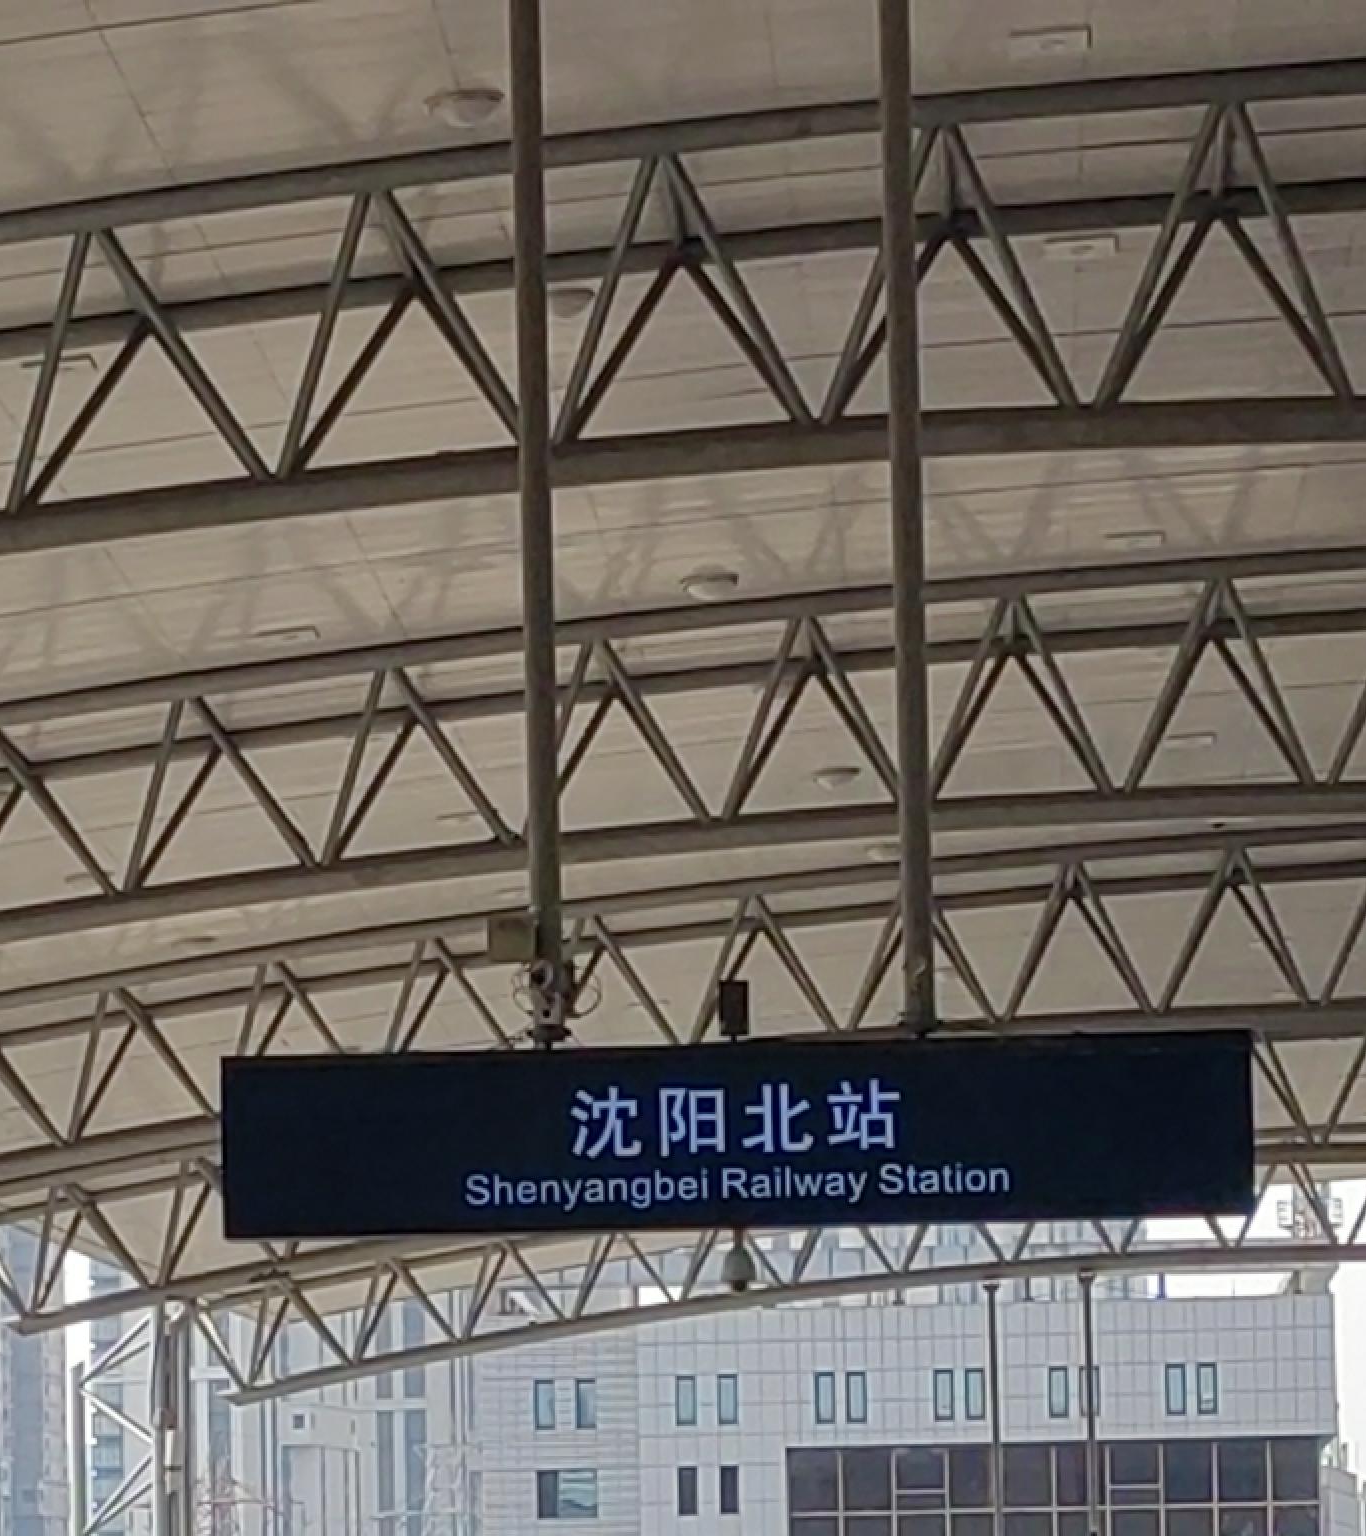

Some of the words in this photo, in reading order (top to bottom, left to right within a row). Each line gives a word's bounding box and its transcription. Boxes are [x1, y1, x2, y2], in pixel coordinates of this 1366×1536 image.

[571, 1079, 902, 1158] 沈阳北站
[465, 1169, 709, 1211] Shenyangbei
[721, 1166, 868, 1203] Railway
[880, 1163, 1009, 1195] Station
